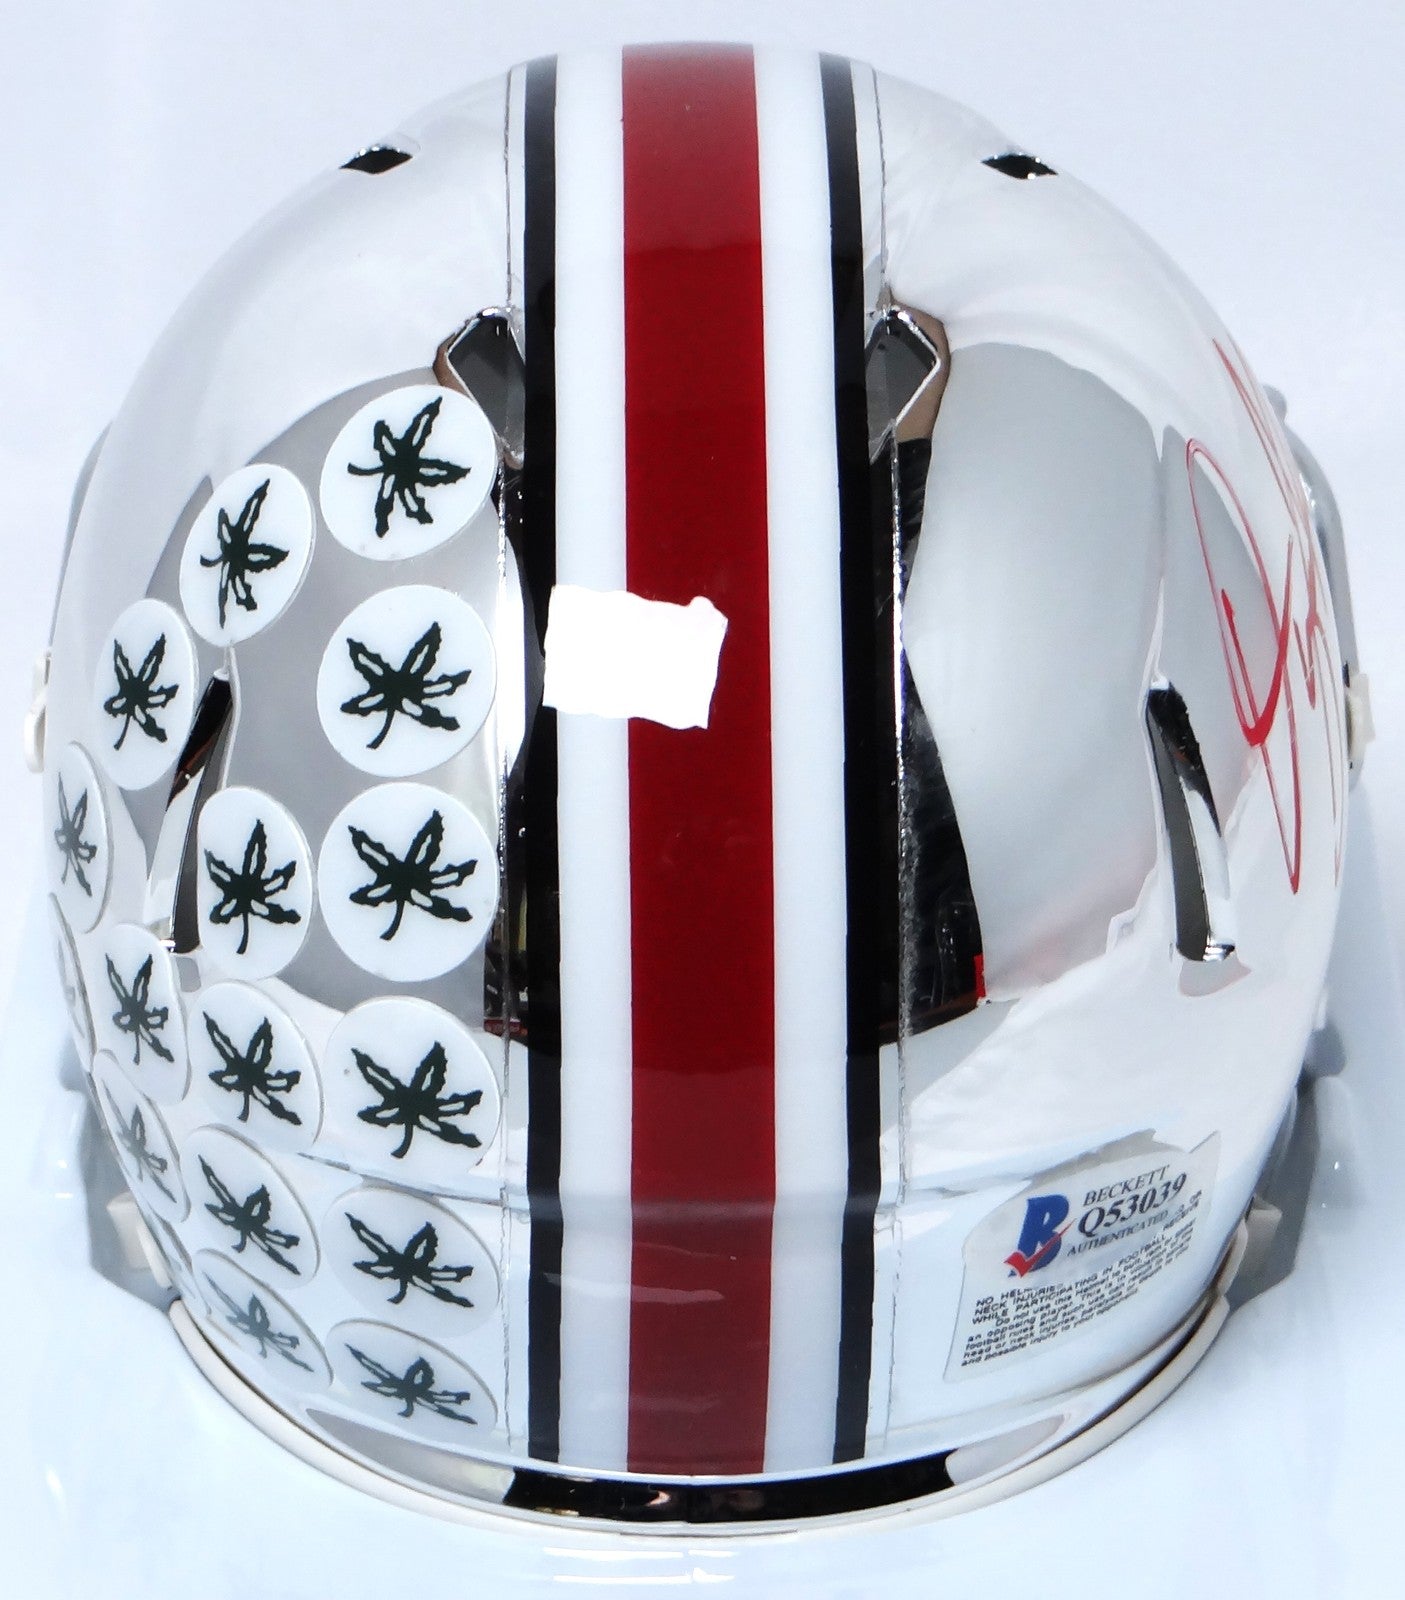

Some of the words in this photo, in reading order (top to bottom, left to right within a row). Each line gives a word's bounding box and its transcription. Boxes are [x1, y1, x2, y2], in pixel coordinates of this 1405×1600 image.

[1078, 1172, 1186, 1238] Q53039
[1083, 1165, 1169, 1206] BECKETT
[1067, 1210, 1168, 1256] AUTHENTICATED
[972, 1308, 1009, 1325] WHILE
[1016, 1273, 1098, 1312] PARTICIPATING
[975, 1300, 1007, 1316] NECK
[976, 1296, 994, 1307] NO
